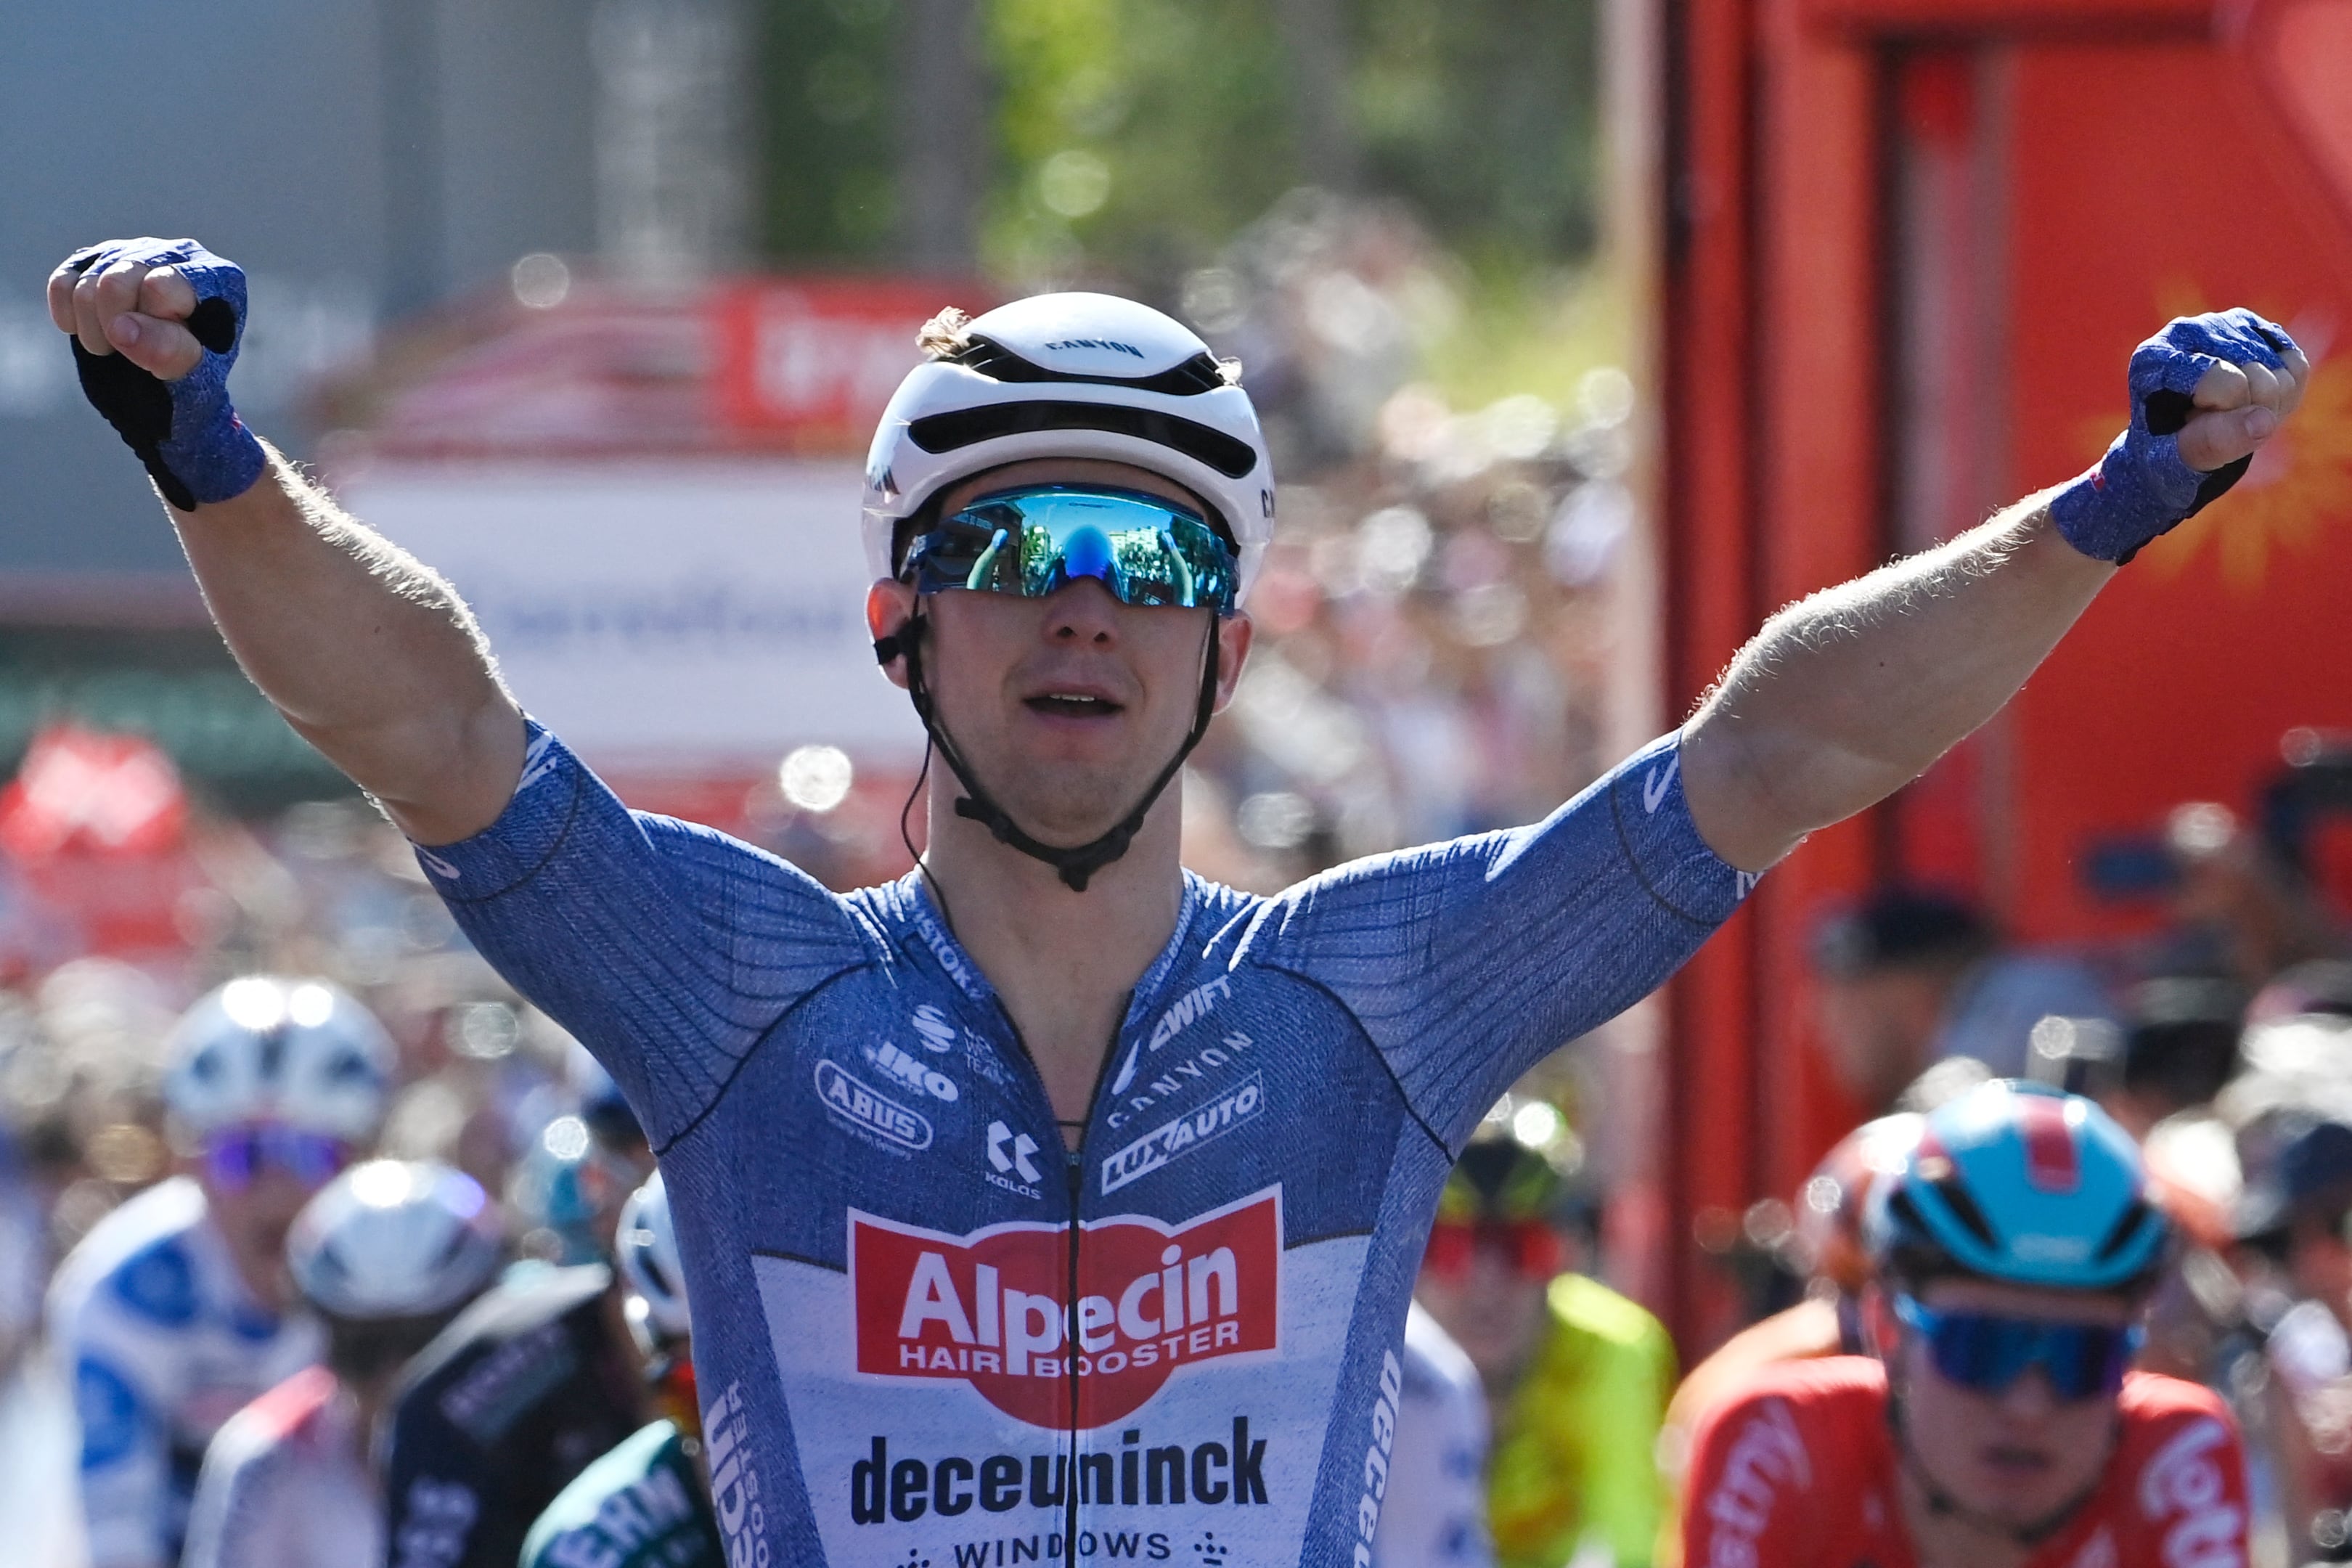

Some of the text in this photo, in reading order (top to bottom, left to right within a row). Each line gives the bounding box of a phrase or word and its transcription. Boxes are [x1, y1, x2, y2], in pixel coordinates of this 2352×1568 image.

[828, 1073, 918, 1140] ABUS
[1106, 1031, 1254, 1129] CANYON
[898, 1244, 1238, 1376] Alpecin
[899, 1320, 1240, 1378] HAIR BOOSTER
[850, 1416, 1269, 1526] deceuninck
[954, 1532, 1172, 1568] WINDOWS
